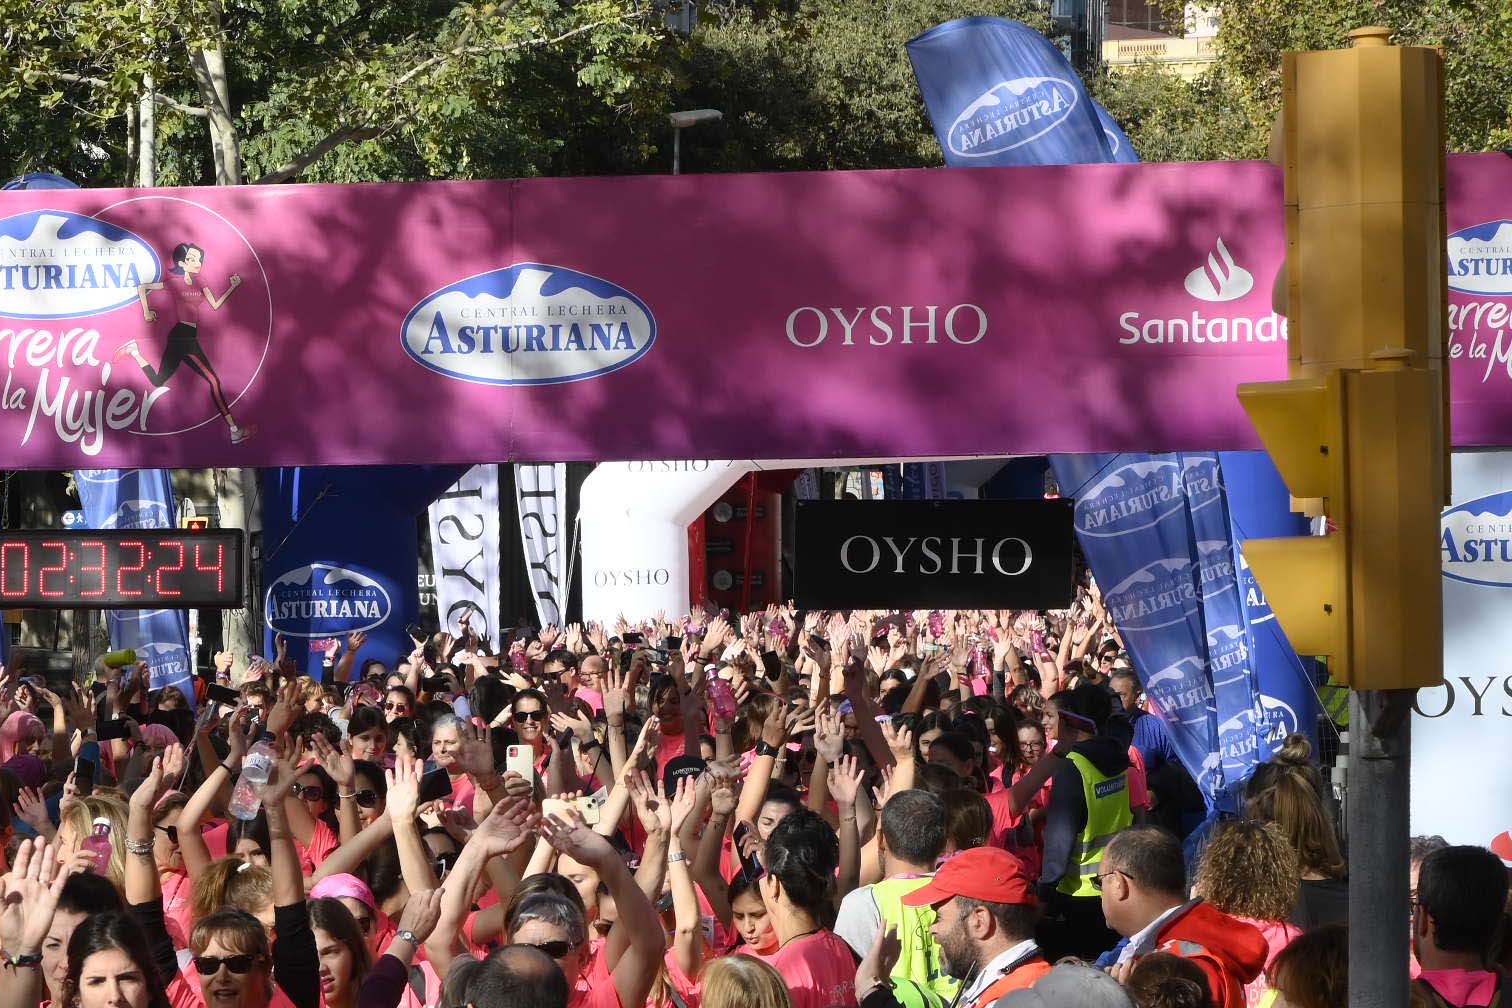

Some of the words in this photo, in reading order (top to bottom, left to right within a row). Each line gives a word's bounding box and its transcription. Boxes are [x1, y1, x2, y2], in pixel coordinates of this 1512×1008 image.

[421, 310, 636, 355] ASTURIANA
[461, 305, 539, 318] CENTRAL
[547, 304, 627, 316] LECHERA
[786, 303, 988, 348] OYSHO
[2, 372, 26, 410] la
[20, 362, 170, 456] Mujer
[0, 542, 225, 596] 02:32:24
[593, 568, 670, 587] OYSHO
[840, 536, 1033, 577] OYSHO
[271, 593, 381, 620] ASTURIANA
